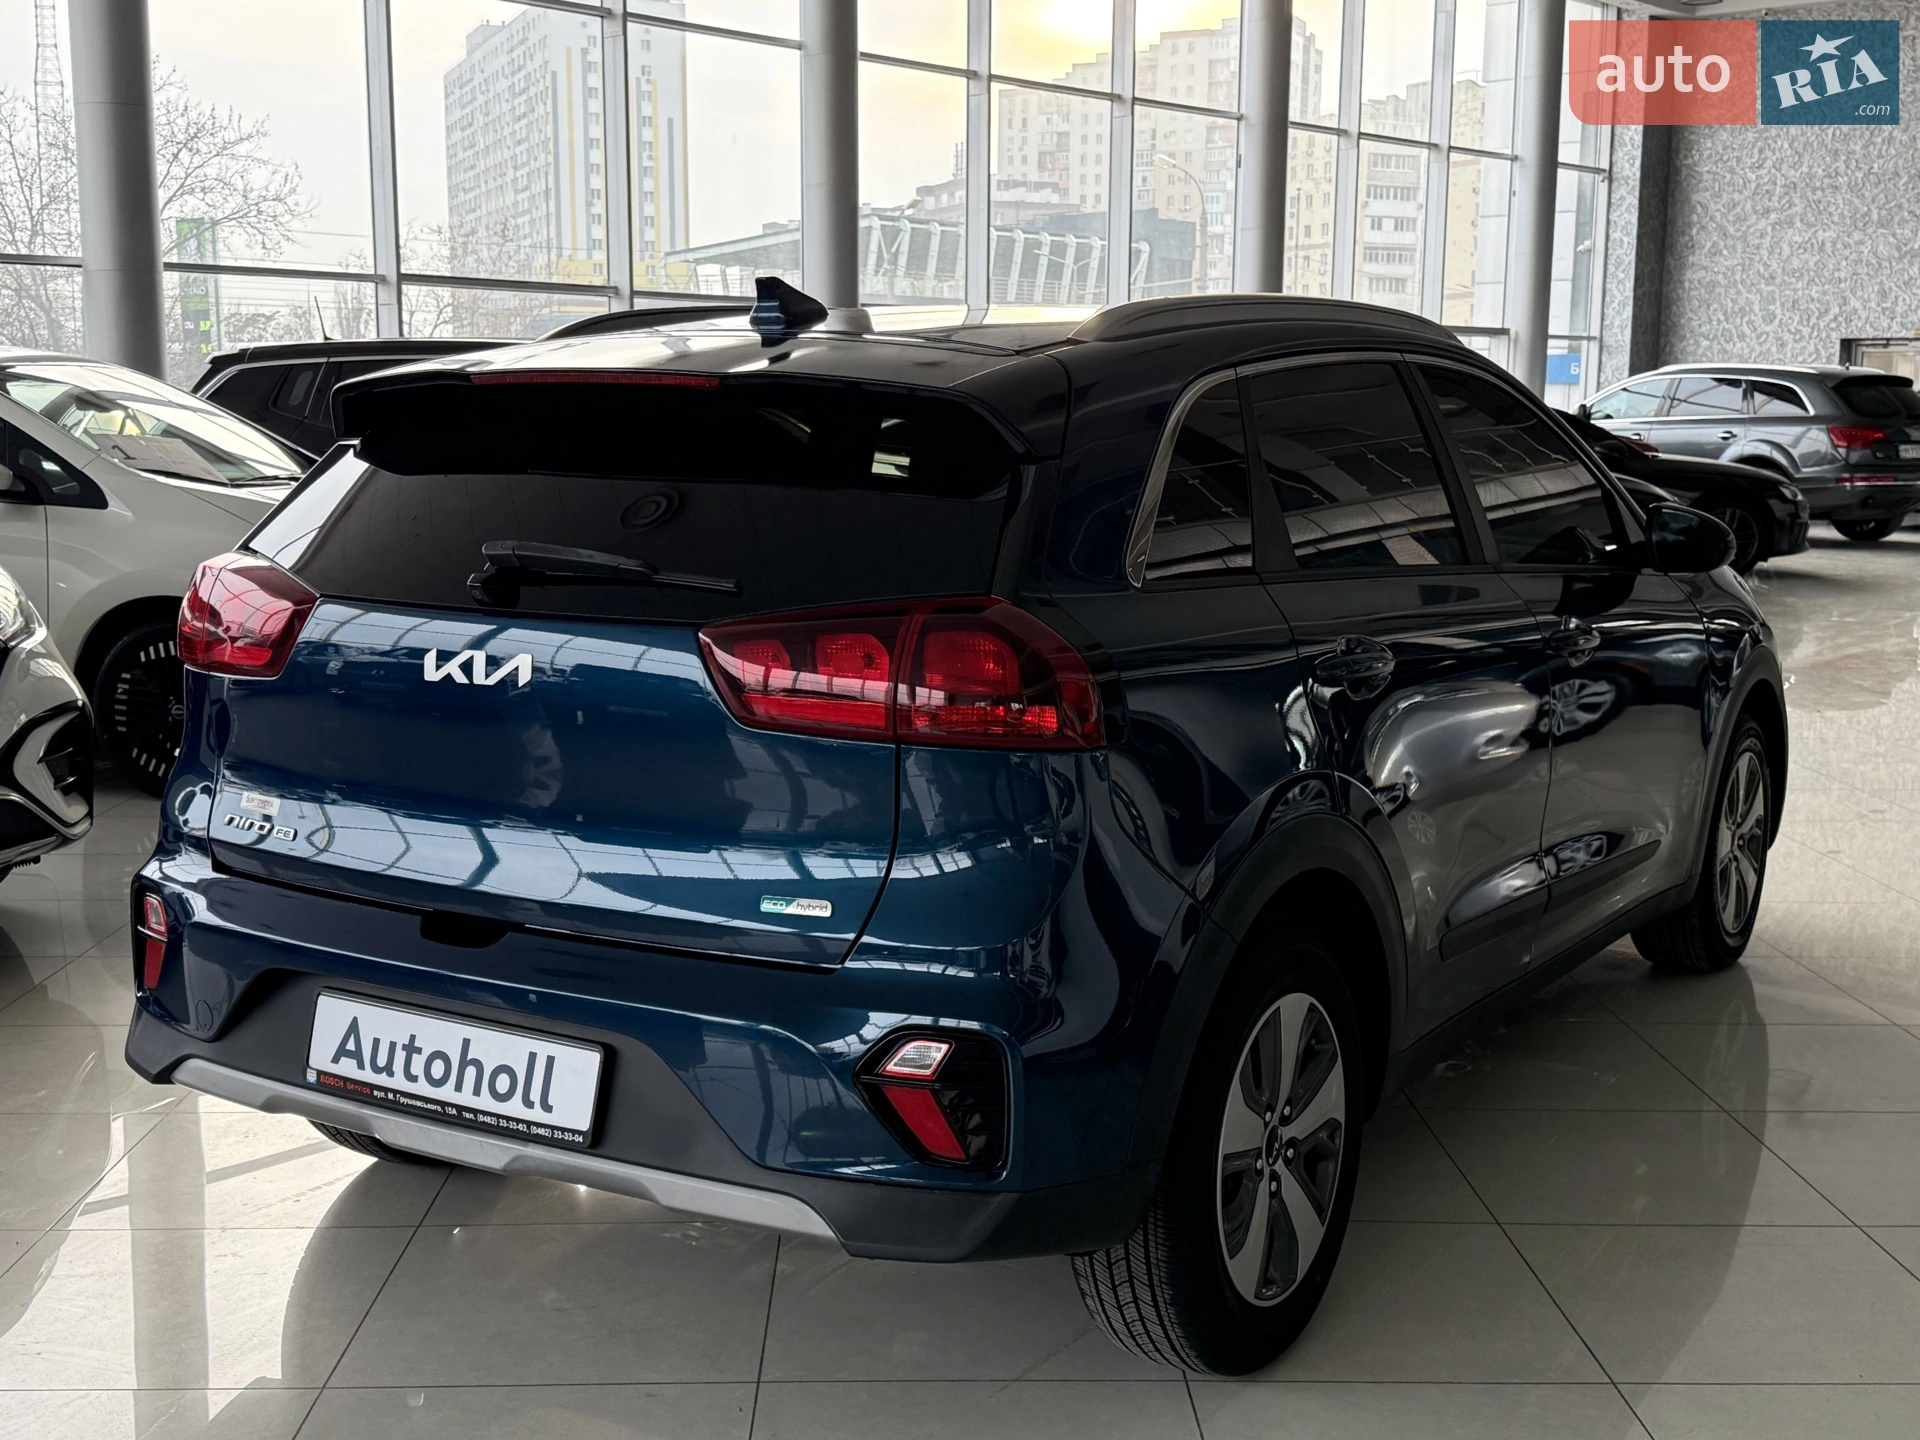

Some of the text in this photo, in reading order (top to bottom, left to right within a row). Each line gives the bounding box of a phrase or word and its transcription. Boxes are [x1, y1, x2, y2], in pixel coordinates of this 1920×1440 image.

[424, 647, 532, 687] KIA
[275, 828, 292, 838] FE
[796, 901, 828, 913] hybrid
[330, 1015, 555, 1114] Autoholl
[320, 1074, 344, 1088] BOSCH
[346, 1081, 371, 1095] Service
[461, 1111, 476, 1120] тел.
[477, 1112, 498, 1126] (0482)
[498, 1118, 529, 1133] 33-33-03,
[530, 1124, 552, 1138] (0482)
[553, 1130, 584, 1143] 33-33-04
